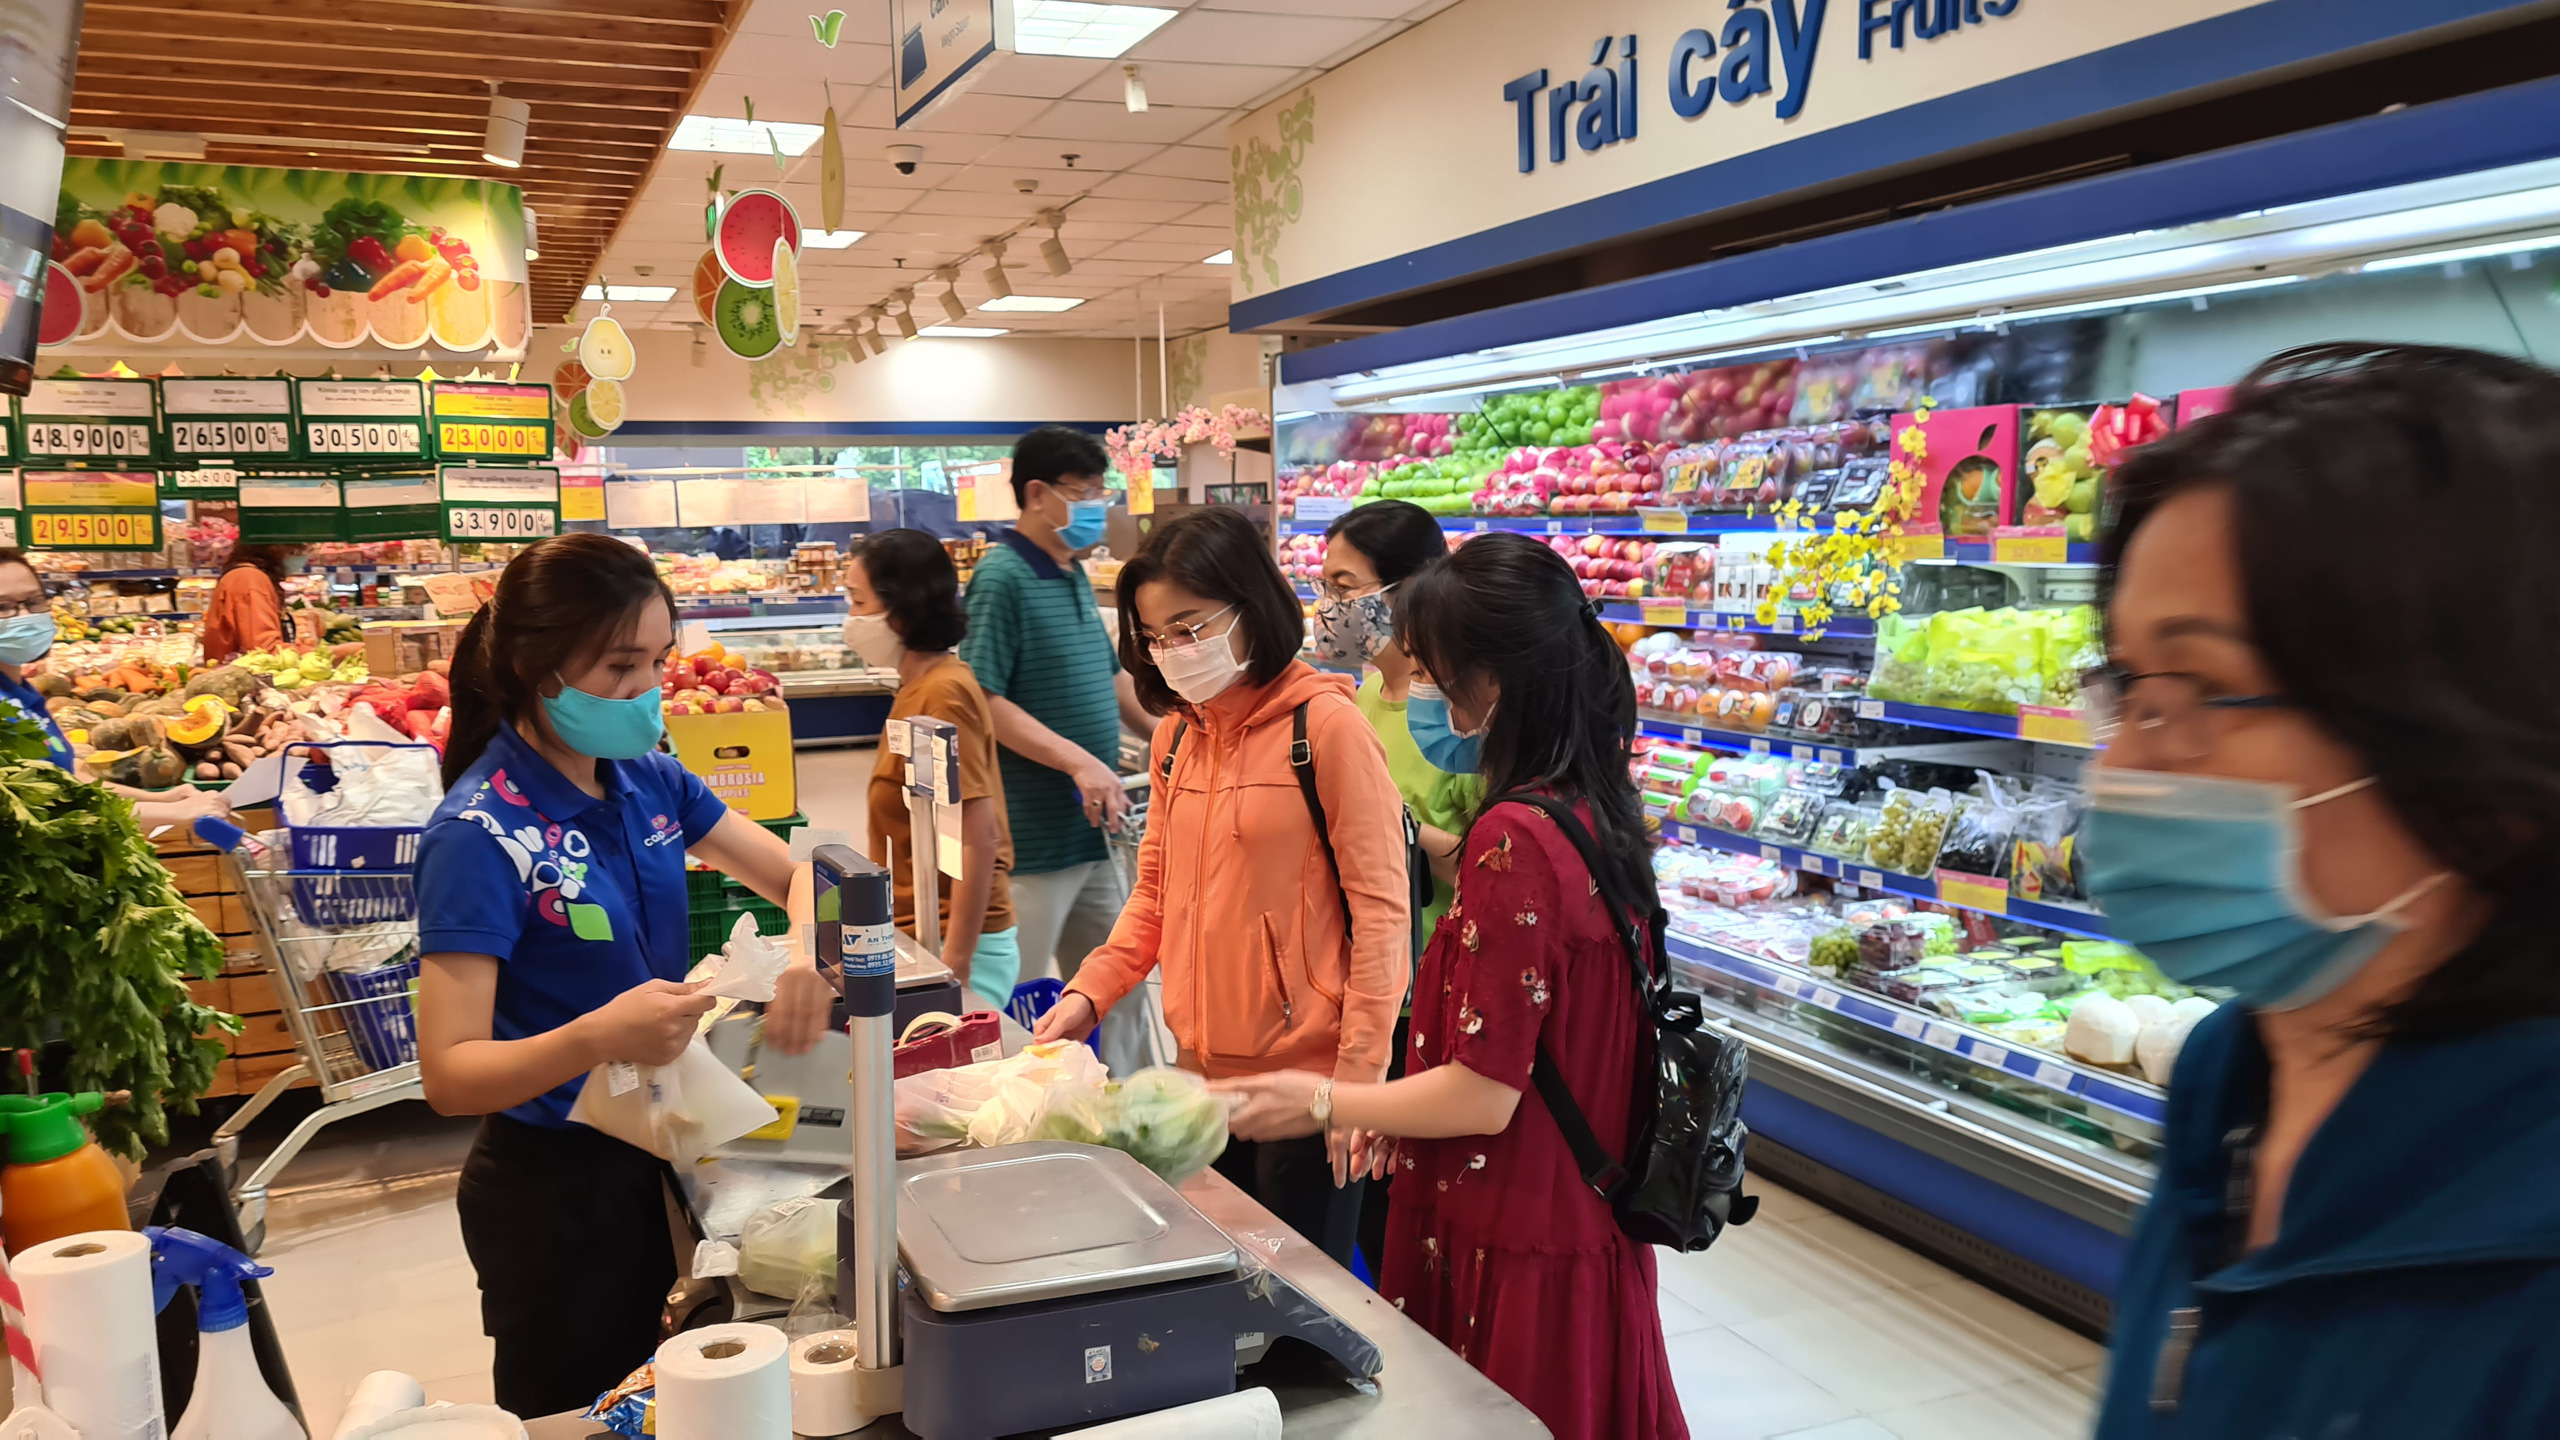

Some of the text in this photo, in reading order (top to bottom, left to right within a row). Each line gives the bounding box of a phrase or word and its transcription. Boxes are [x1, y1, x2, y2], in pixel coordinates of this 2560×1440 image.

[1504, 34, 1638, 174] Trái
[1668, 0, 1823, 119] cây
[32, 428, 124, 449] 48.900
[176, 426, 266, 446] 26.500
[313, 428, 397, 446] 30.500
[445, 427, 524, 447] 23.000
[36, 518, 129, 539] 29.500
[454, 512, 534, 533] 33.900
